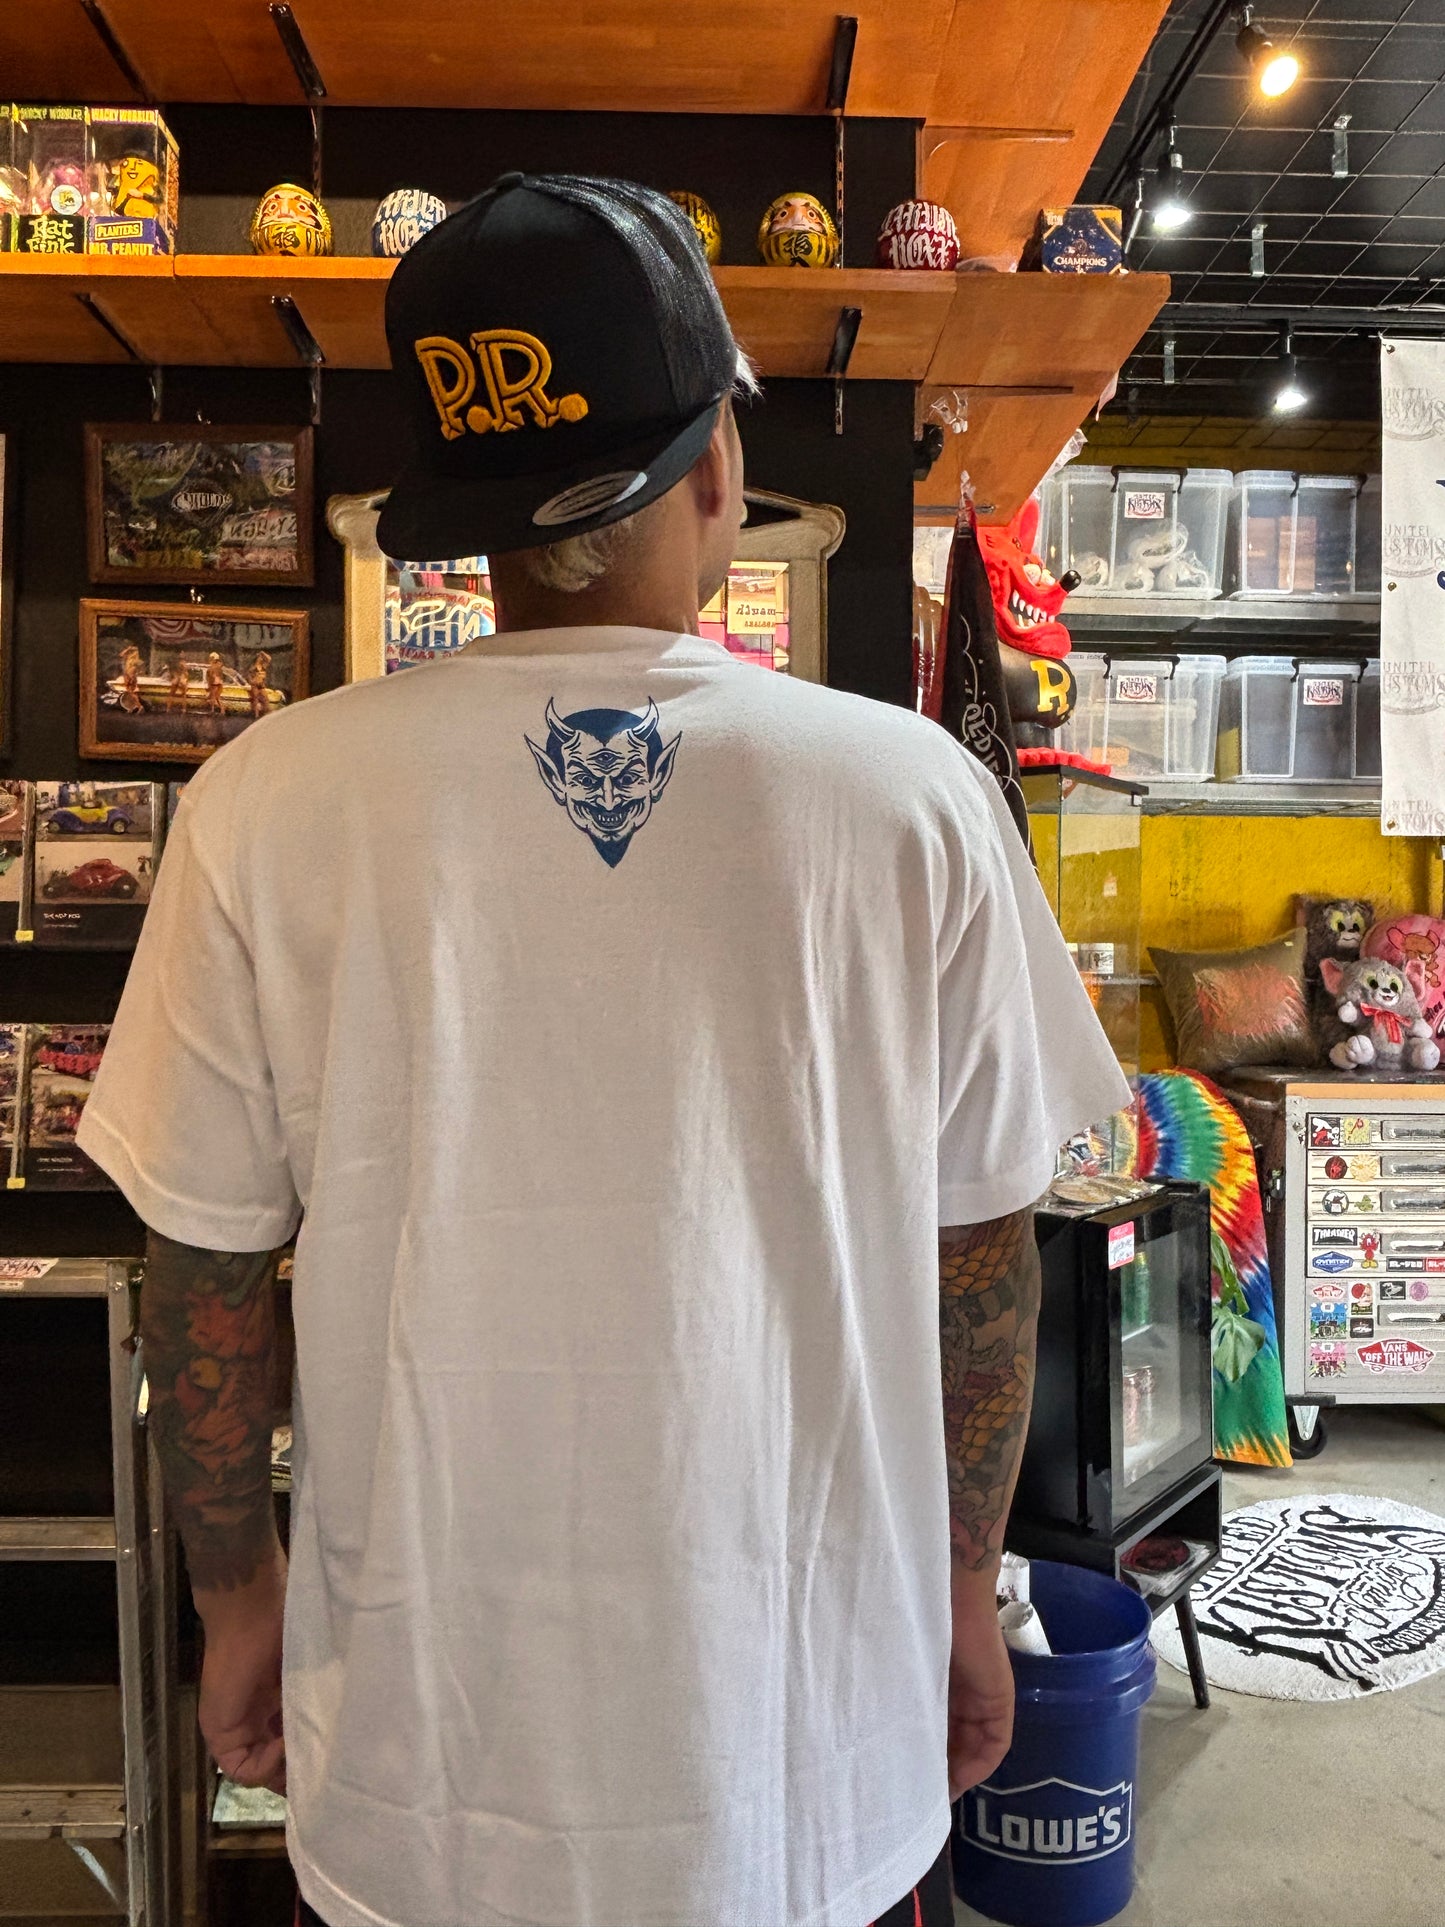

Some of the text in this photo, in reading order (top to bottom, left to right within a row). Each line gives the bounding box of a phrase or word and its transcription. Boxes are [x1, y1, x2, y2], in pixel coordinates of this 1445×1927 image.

[28, 214, 74, 239] Rat
[97, 223, 141, 238] PLANTERS
[26, 237, 75, 253] Fink
[89, 242, 154, 256] MR. PEANUT
[1053, 256, 1107, 267] CHAMPIONS
[1380, 1342, 1408, 1353] VANS
[1384, 1352, 1404, 1366] THE
[976, 1799, 1122, 1854] LOWE'S
